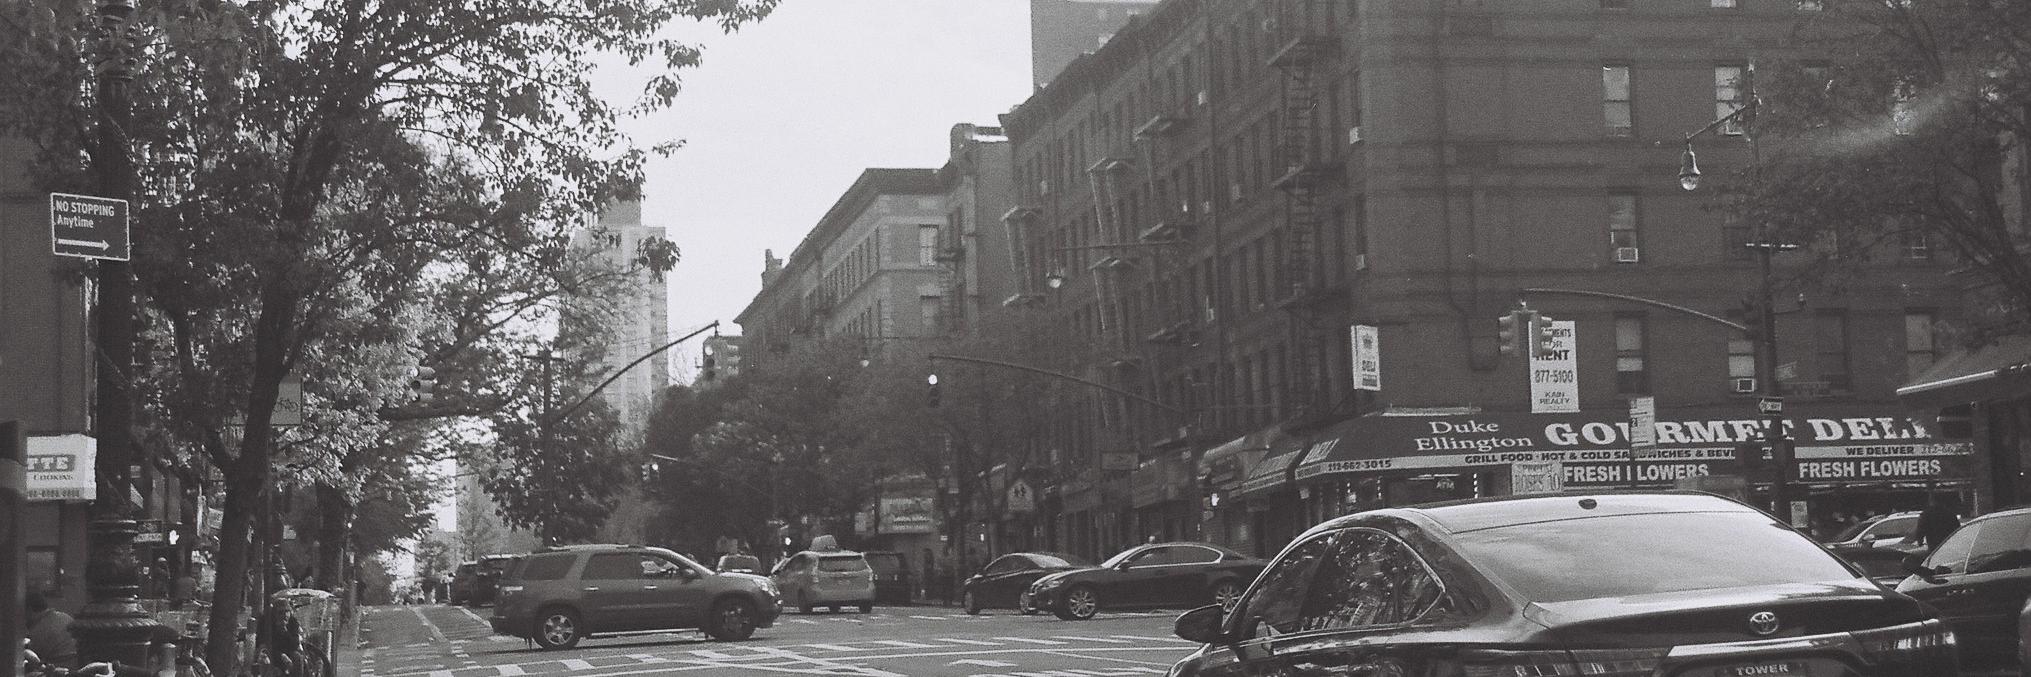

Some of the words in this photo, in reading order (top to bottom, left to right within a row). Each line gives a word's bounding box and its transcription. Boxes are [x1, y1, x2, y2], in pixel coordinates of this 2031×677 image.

[56, 200, 69, 212] NO
[71, 201, 115, 217] STOPPING
[57, 213, 94, 228] Anytime
[1535, 369, 1574, 384] 877-5100
[1429, 420, 1499, 434] Duke
[1414, 437, 1534, 452] Ellington
[1846, 447, 1865, 456] WE
[1866, 446, 1915, 456] DELIVER
[1465, 454, 1498, 464] GRILL
[1501, 452, 1533, 462] FOOD
[1541, 451, 1566, 460] HOT
[1581, 450, 1612, 460] COLD
[1563, 464, 1621, 483] FRESH
[1799, 460, 1855, 479] FRESH
[1860, 458, 1942, 478] FLOWERS
[1736, 662, 1789, 676] TOWER
